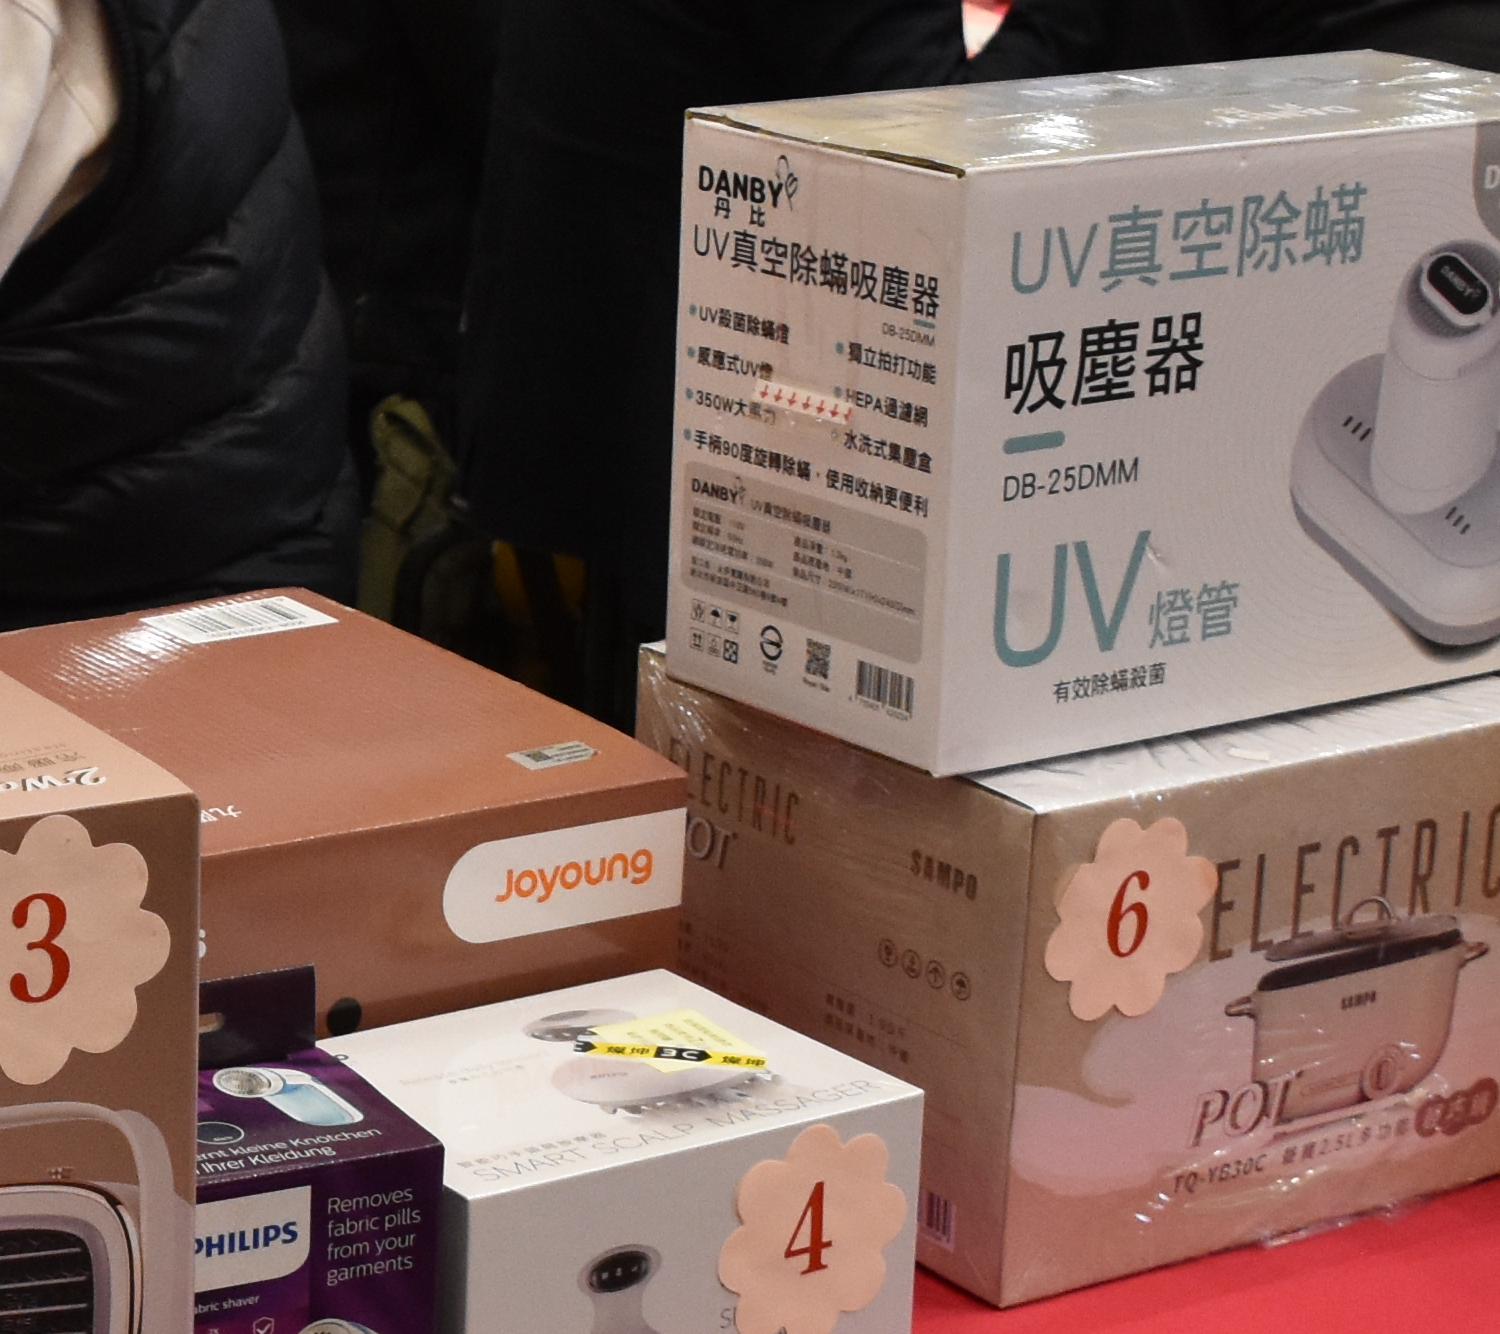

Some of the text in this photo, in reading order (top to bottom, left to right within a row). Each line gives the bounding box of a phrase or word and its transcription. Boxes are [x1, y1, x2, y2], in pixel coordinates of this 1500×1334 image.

[698, 165, 783, 209] DANBY
[714, 197, 765, 227] 丹比
[1011, 182, 1367, 294] UV真空除蟎
[693, 224, 941, 320] UV真空除蟎吸塵器
[881, 322, 936, 347] DB-25DMM
[848, 342, 937, 384] 獨立拍打功能
[1004, 312, 1205, 416] 吸塵器
[691, 478, 739, 504] DANBY
[1003, 458, 1139, 502] DB-25DMM
[1053, 661, 1167, 703] 有效除蟎殺菌
[687, 814, 738, 870] OT
[494, 848, 653, 905] Joyoung
[909, 848, 978, 901] SAMPO
[1106, 869, 1150, 959] 6
[10, 893, 71, 1004] 3
[234, 1140, 287, 1156] kleine
[289, 1128, 382, 1147] Knötchen
[472, 1080, 880, 1182] SMART SCALP MASSAGER
[204, 1145, 336, 1174] Ihrer Kleidung
[327, 1187, 413, 1215] Removes
[327, 1208, 421, 1238] fabric pills
[785, 1181, 833, 1275] 4
[327, 1232, 417, 1261] from your
[327, 1255, 414, 1286] garments
[222, 1294, 260, 1310] shaver
